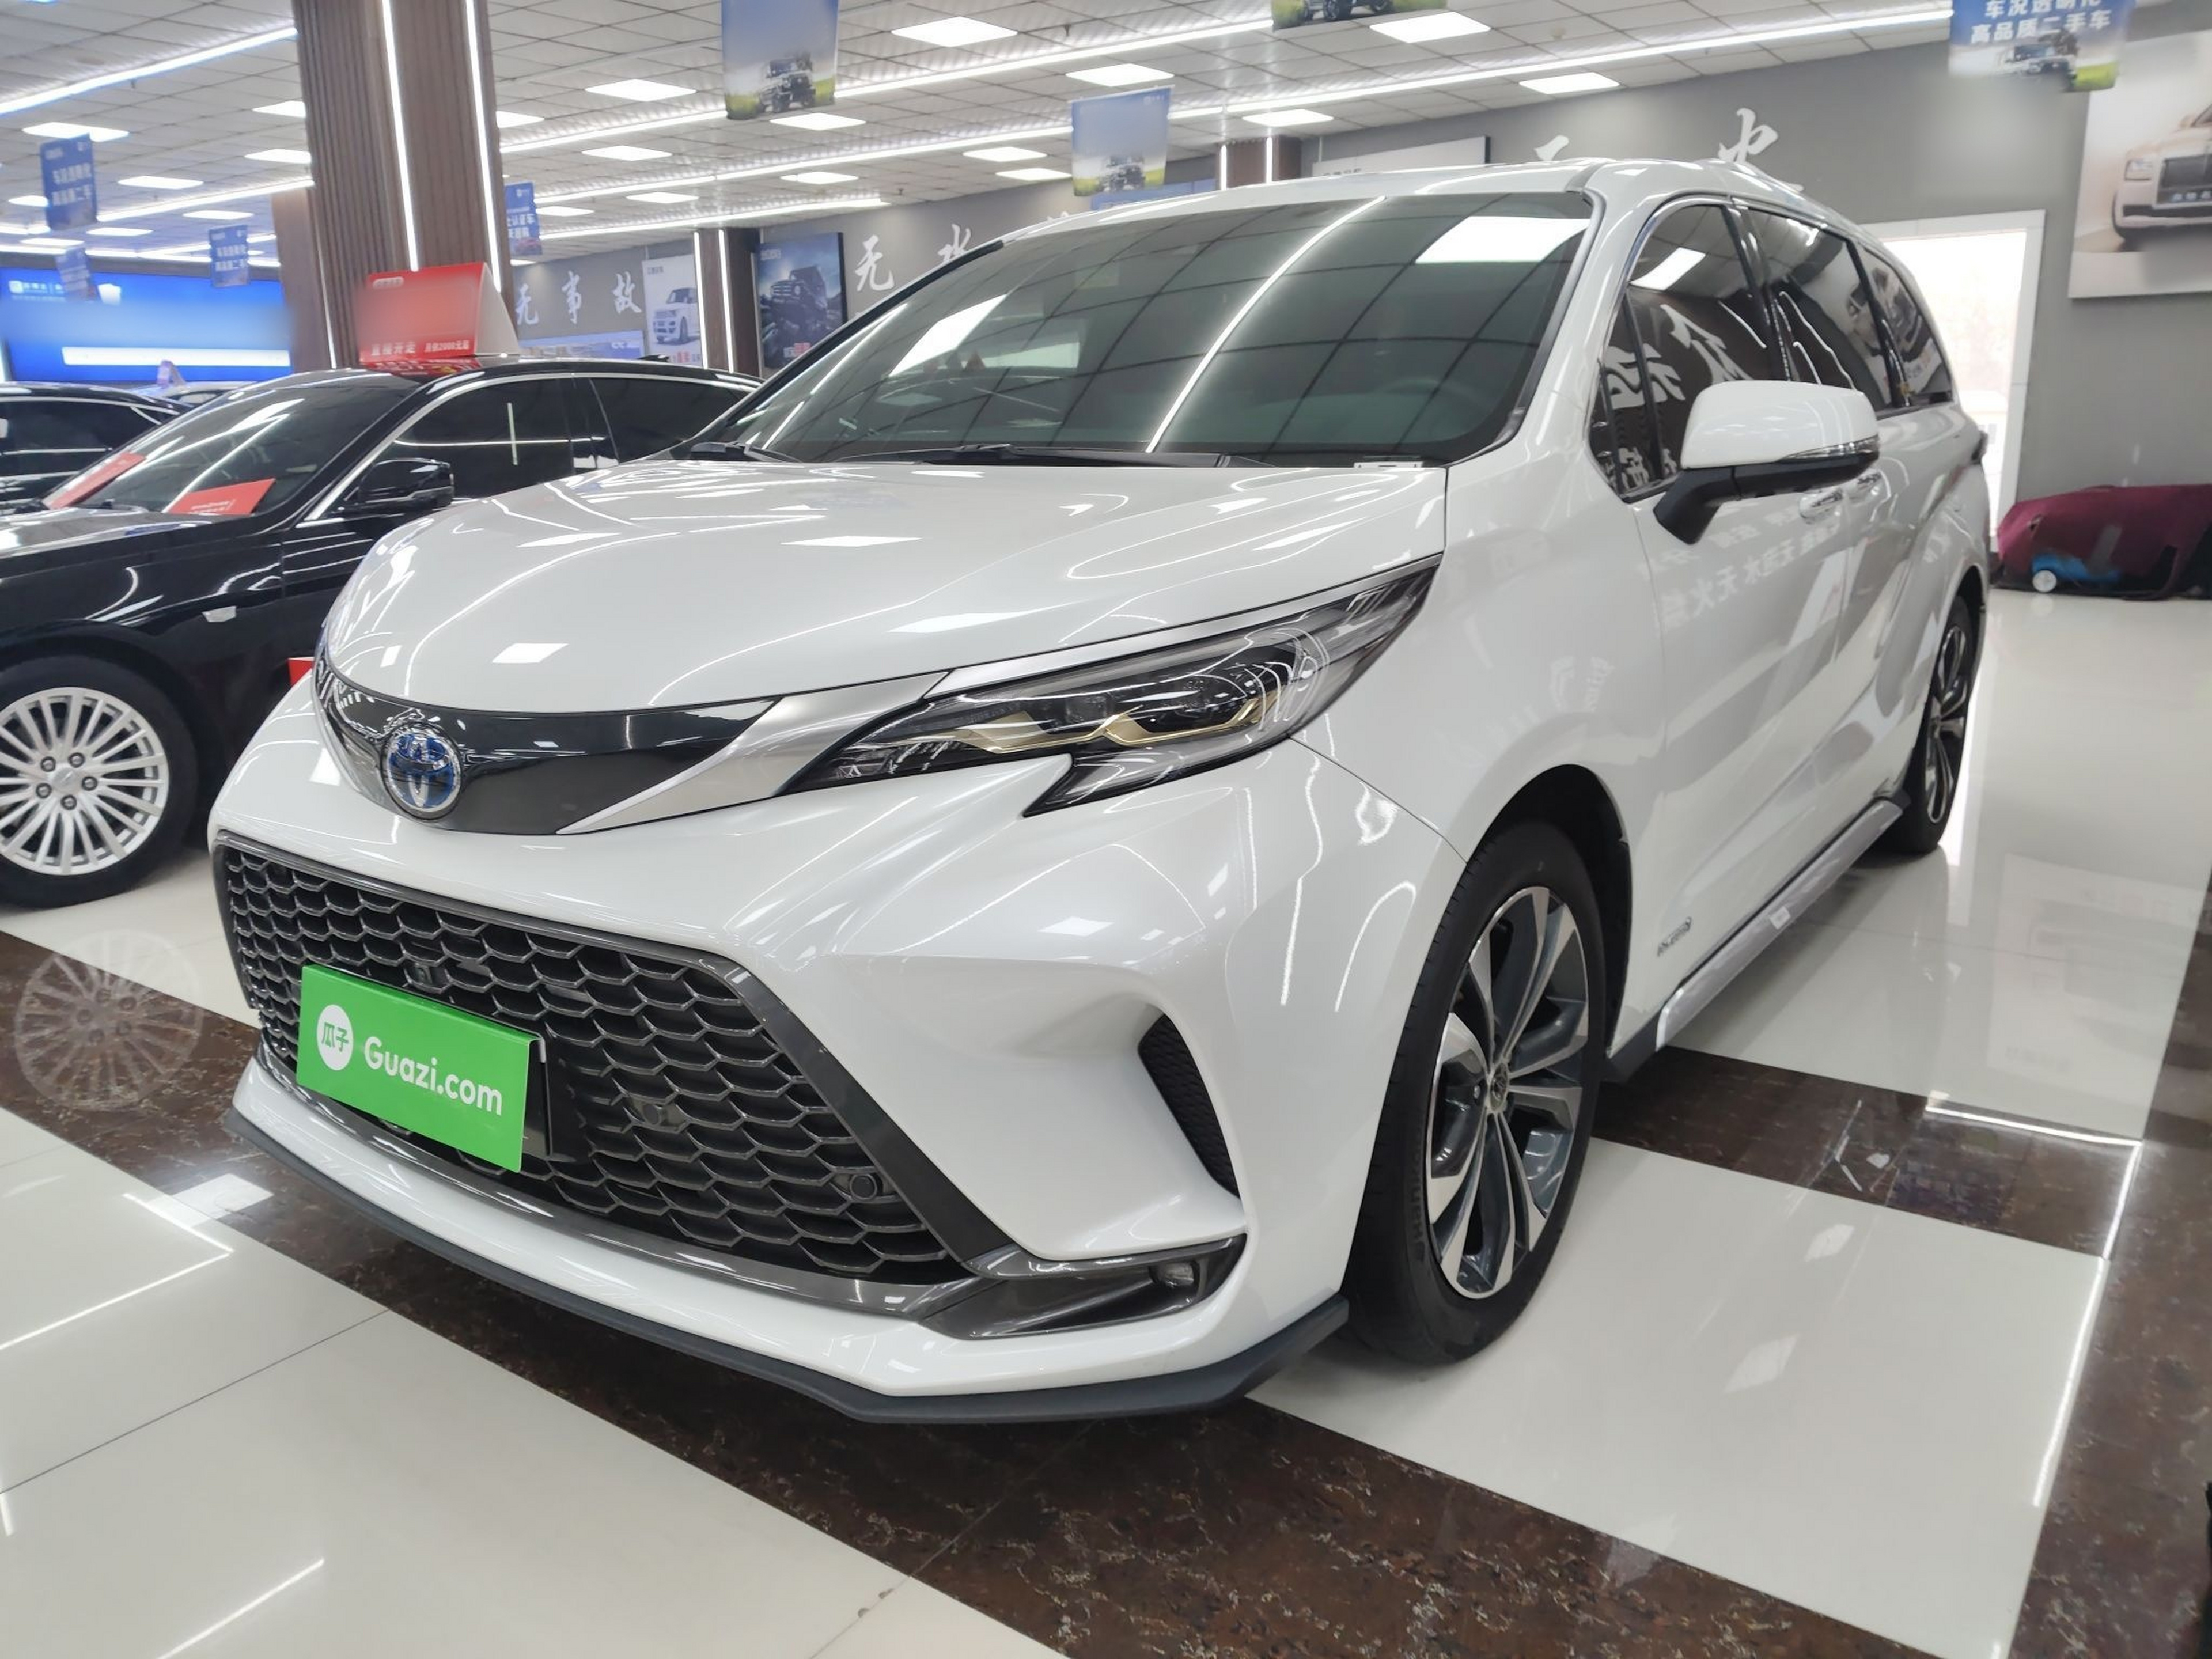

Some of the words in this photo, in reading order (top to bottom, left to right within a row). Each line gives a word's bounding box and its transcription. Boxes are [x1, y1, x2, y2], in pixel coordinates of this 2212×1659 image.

[1971, 10, 2112, 44] 高品质二手车
[515, 270, 642, 325] 无事故
[321, 1021, 349, 1052] 瓜子
[363, 1036, 502, 1116] Guazi.com
